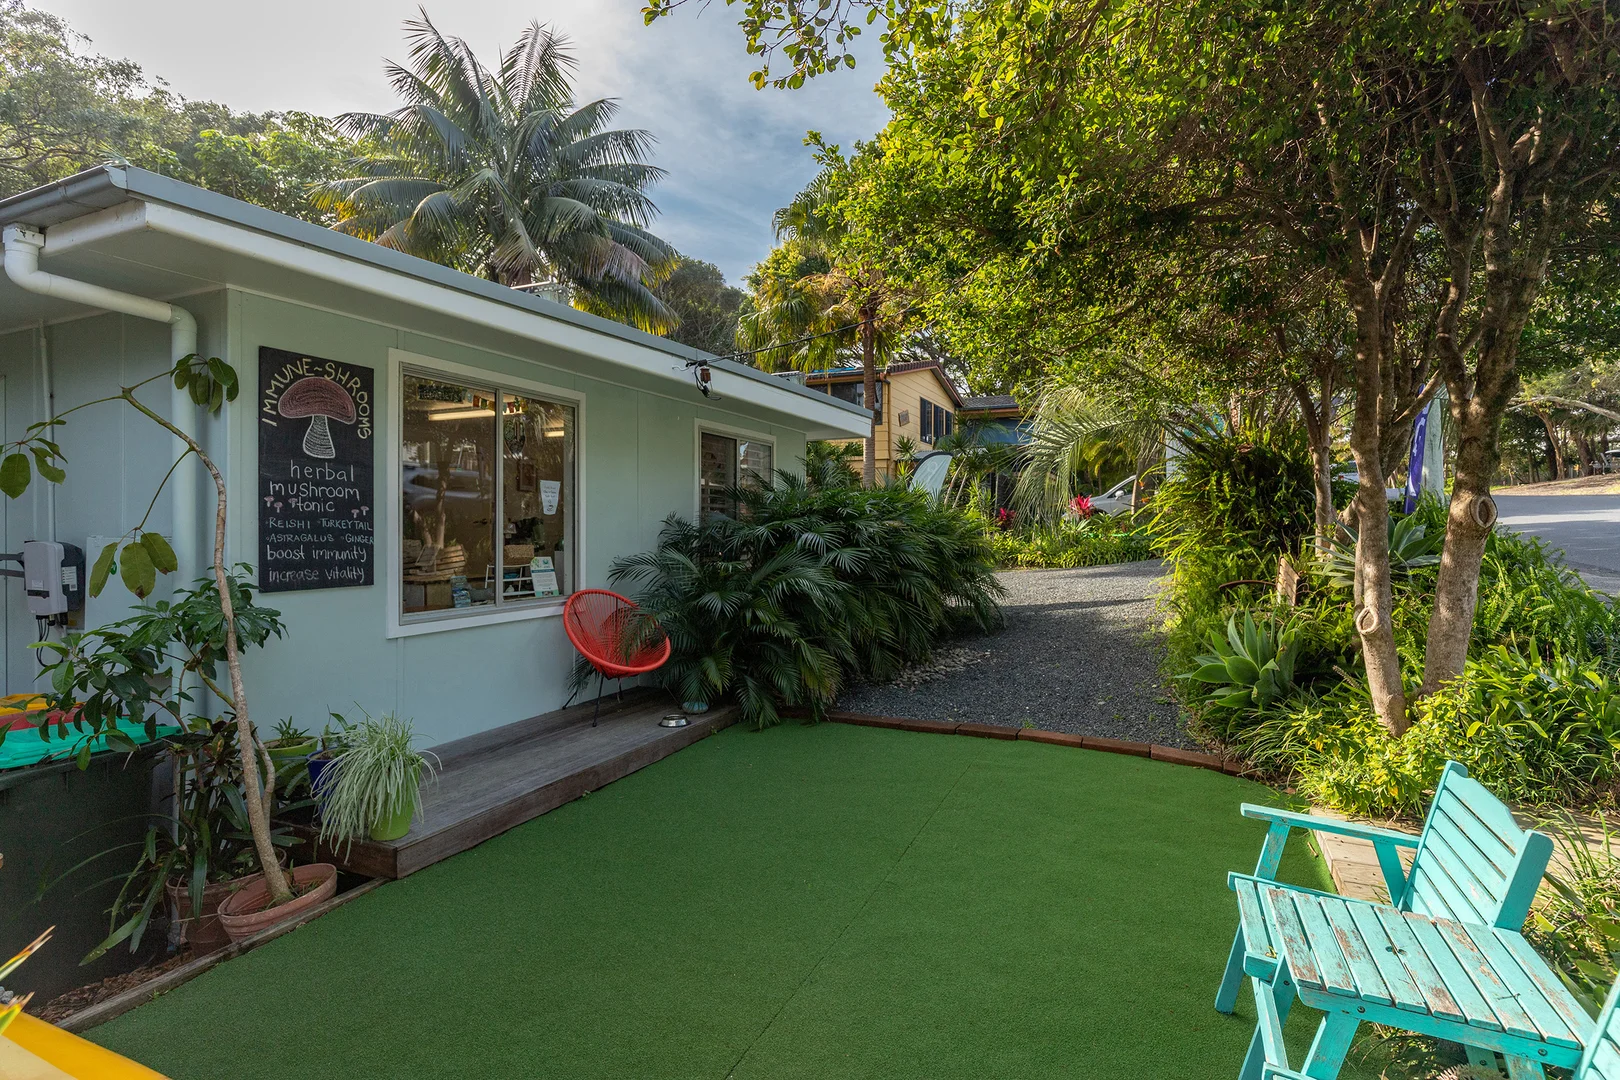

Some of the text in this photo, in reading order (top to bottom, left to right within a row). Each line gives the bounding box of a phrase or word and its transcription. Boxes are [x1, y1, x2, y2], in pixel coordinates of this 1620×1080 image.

[290, 460, 354, 482] herbal
[269, 481, 360, 501] mushroom
[297, 496, 335, 512] tonic
[269, 517, 310, 529] REISHI
[266, 544, 367, 563] boost immunity
[268, 565, 365, 583] increase vitality
